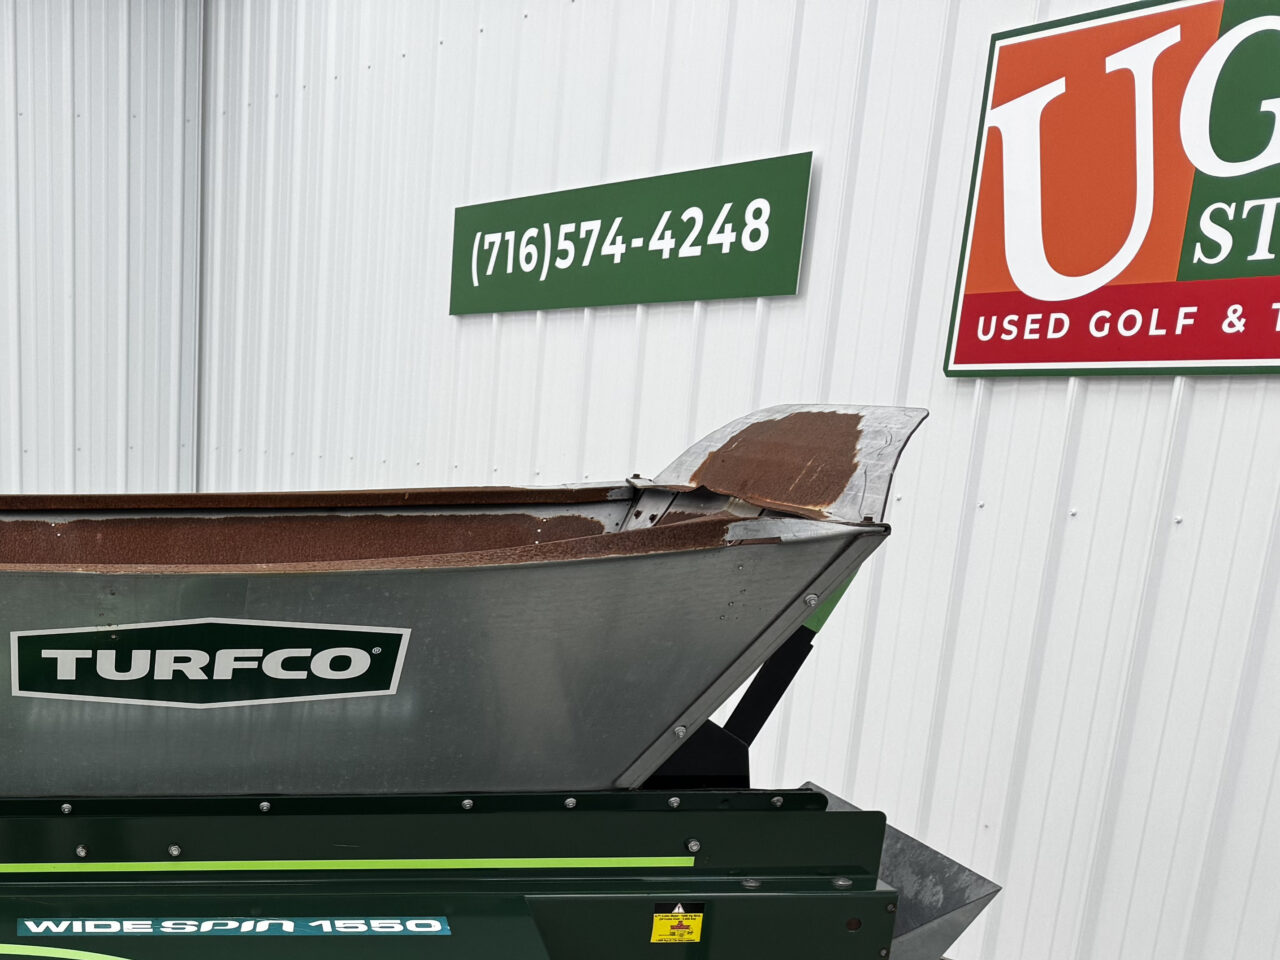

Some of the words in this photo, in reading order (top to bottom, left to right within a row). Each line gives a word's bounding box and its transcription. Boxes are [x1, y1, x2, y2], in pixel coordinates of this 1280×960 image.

[471, 197, 771, 287] (716)574-4248
[976, 312, 1070, 342] USED
[1088, 306, 1198, 338] GOLF
[1221, 303, 1247, 334] &
[308, 918, 442, 934] 1550
